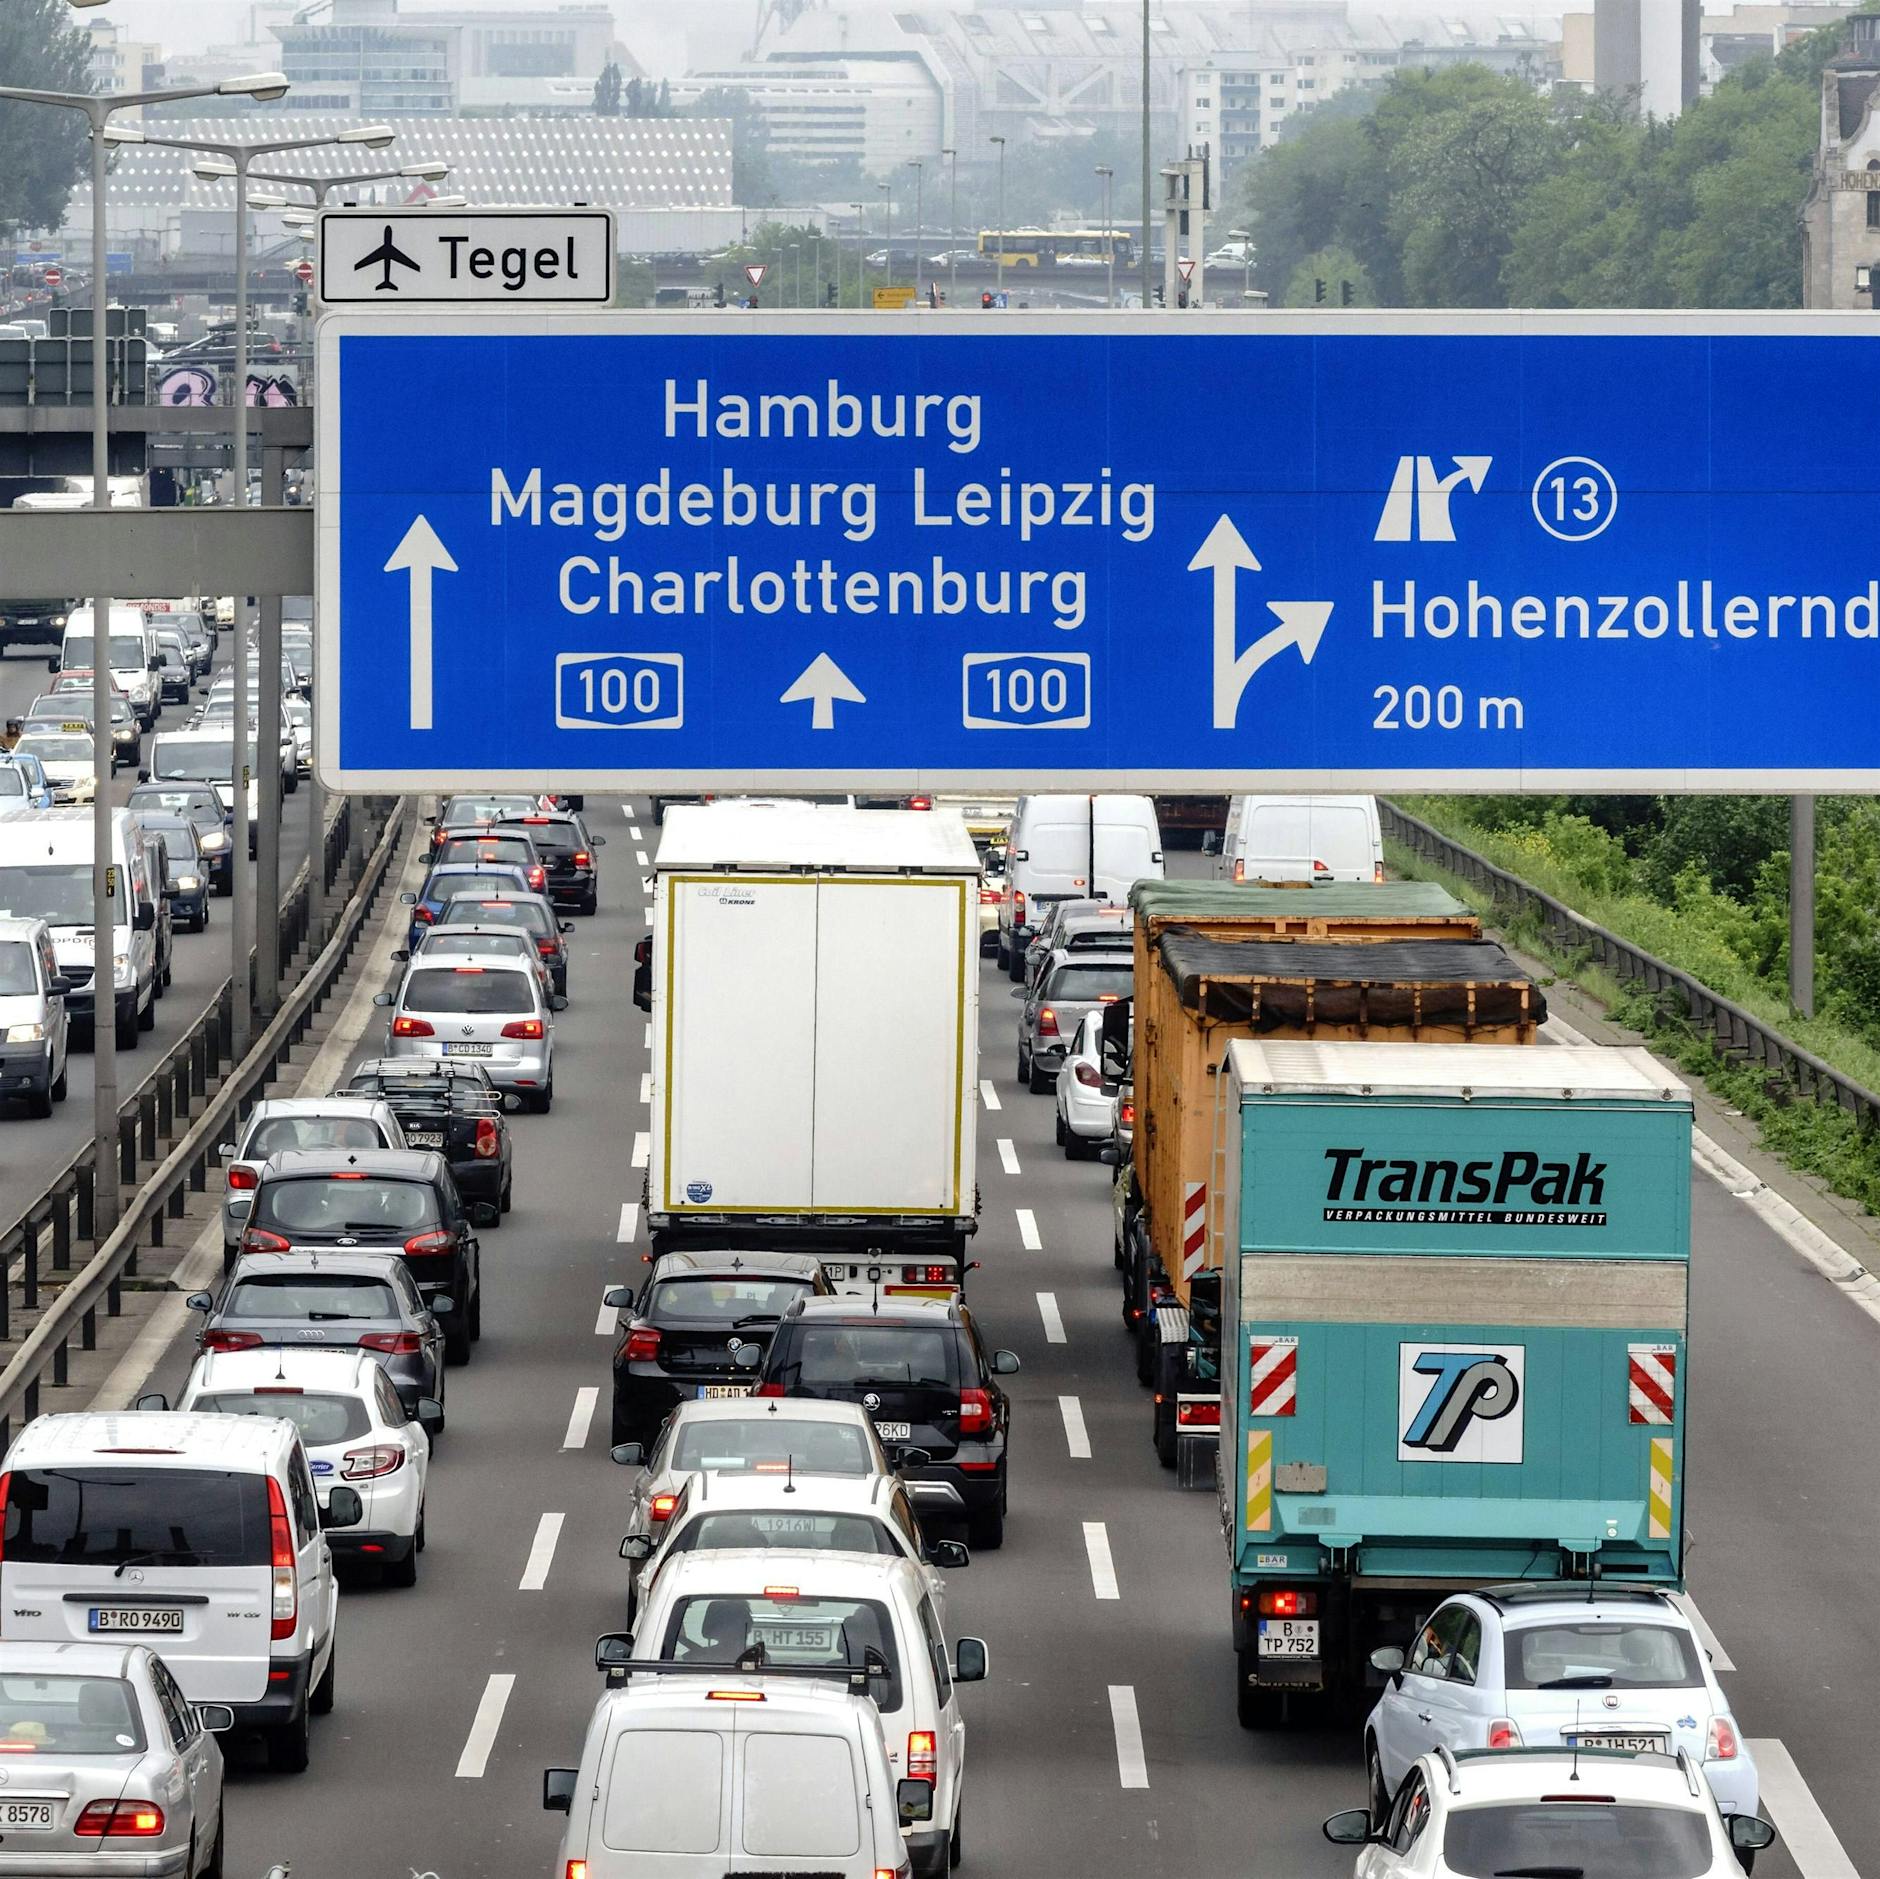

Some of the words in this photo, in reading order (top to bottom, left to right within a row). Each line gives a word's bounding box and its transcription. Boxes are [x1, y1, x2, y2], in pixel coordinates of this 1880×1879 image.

[1840, 172, 1880, 190] HOHEN
[439, 236, 579, 291] Tegel
[665, 380, 981, 454] Hamburg
[491, 468, 876, 542] Magdeburg
[914, 468, 1155, 542] Leipzig
[1550, 477, 1598, 521] 13
[559, 556, 1086, 630] Charlottenburg
[1373, 580, 1880, 639] Hohenzollernd
[579, 668, 660, 714] 100
[986, 668, 1067, 714] 100
[1373, 684, 1463, 730] 200
[1479, 696, 1524, 729] m
[448, 1045, 454, 1053] B
[418, 1133, 442, 1143] 7923
[1324, 1147, 1608, 1205] TransPak
[1325, 1209, 1494, 1223] VERPACKUNGSMITTEL
[1503, 1212, 1606, 1225] BUNDESWEIT
[1278, 1336, 1296, 1344] BAR
[705, 1387, 719, 1399] HD
[767, 1519, 812, 1531] 1916W
[1265, 1556, 1286, 1564] BAR
[99, 1610, 110, 1626] B
[119, 1610, 139, 1627] RO
[142, 1610, 181, 1628] 9490
[753, 1629, 762, 1644] B
[772, 1630, 793, 1646] HT
[796, 1631, 825, 1646] 155
[1283, 1622, 1293, 1636] B
[1264, 1638, 1283, 1652] TP
[1287, 1638, 1315, 1653] 752
[1627, 1739, 1656, 1752] 521
[7, 1805, 50, 1823] 8578
